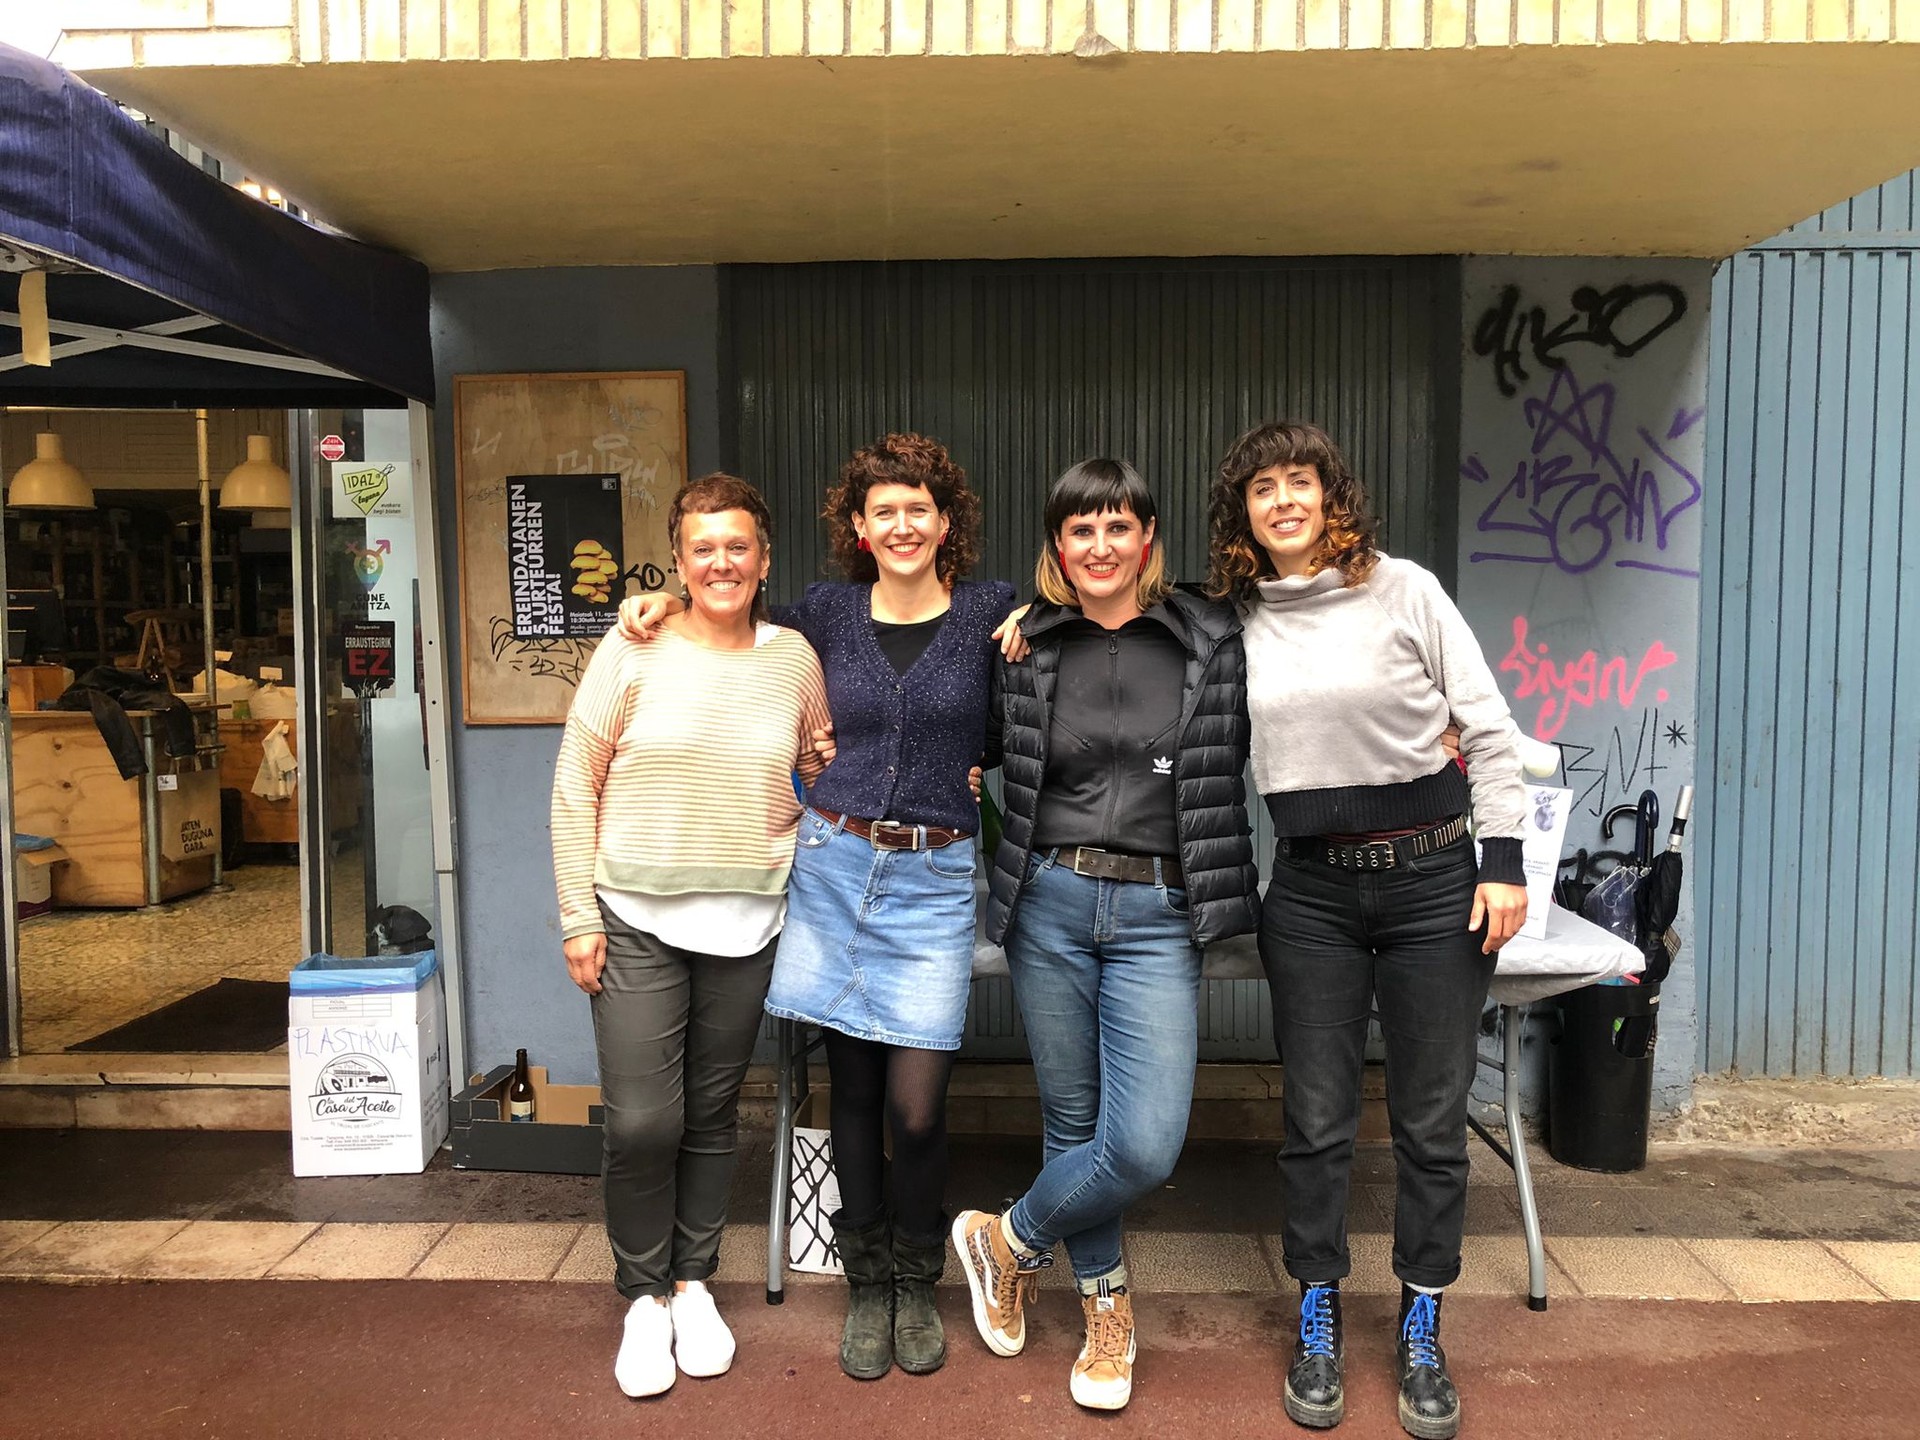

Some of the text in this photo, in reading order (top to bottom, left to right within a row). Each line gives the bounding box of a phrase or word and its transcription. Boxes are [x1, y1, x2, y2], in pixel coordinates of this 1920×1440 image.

[347, 473, 375, 489] IDAZ
[511, 484, 533, 636] EREINDAJANEN
[356, 593, 385, 602] GUNE
[546, 573, 565, 636] FESTA!
[350, 602, 391, 611] ANITZA
[345, 637, 392, 649] ERRAUSTEGIRIK
[349, 649, 390, 676] EZ
[181, 828, 214, 843] DUGUNA
[316, 1098, 348, 1116] Casa
[349, 1096, 396, 1117] Aceite
